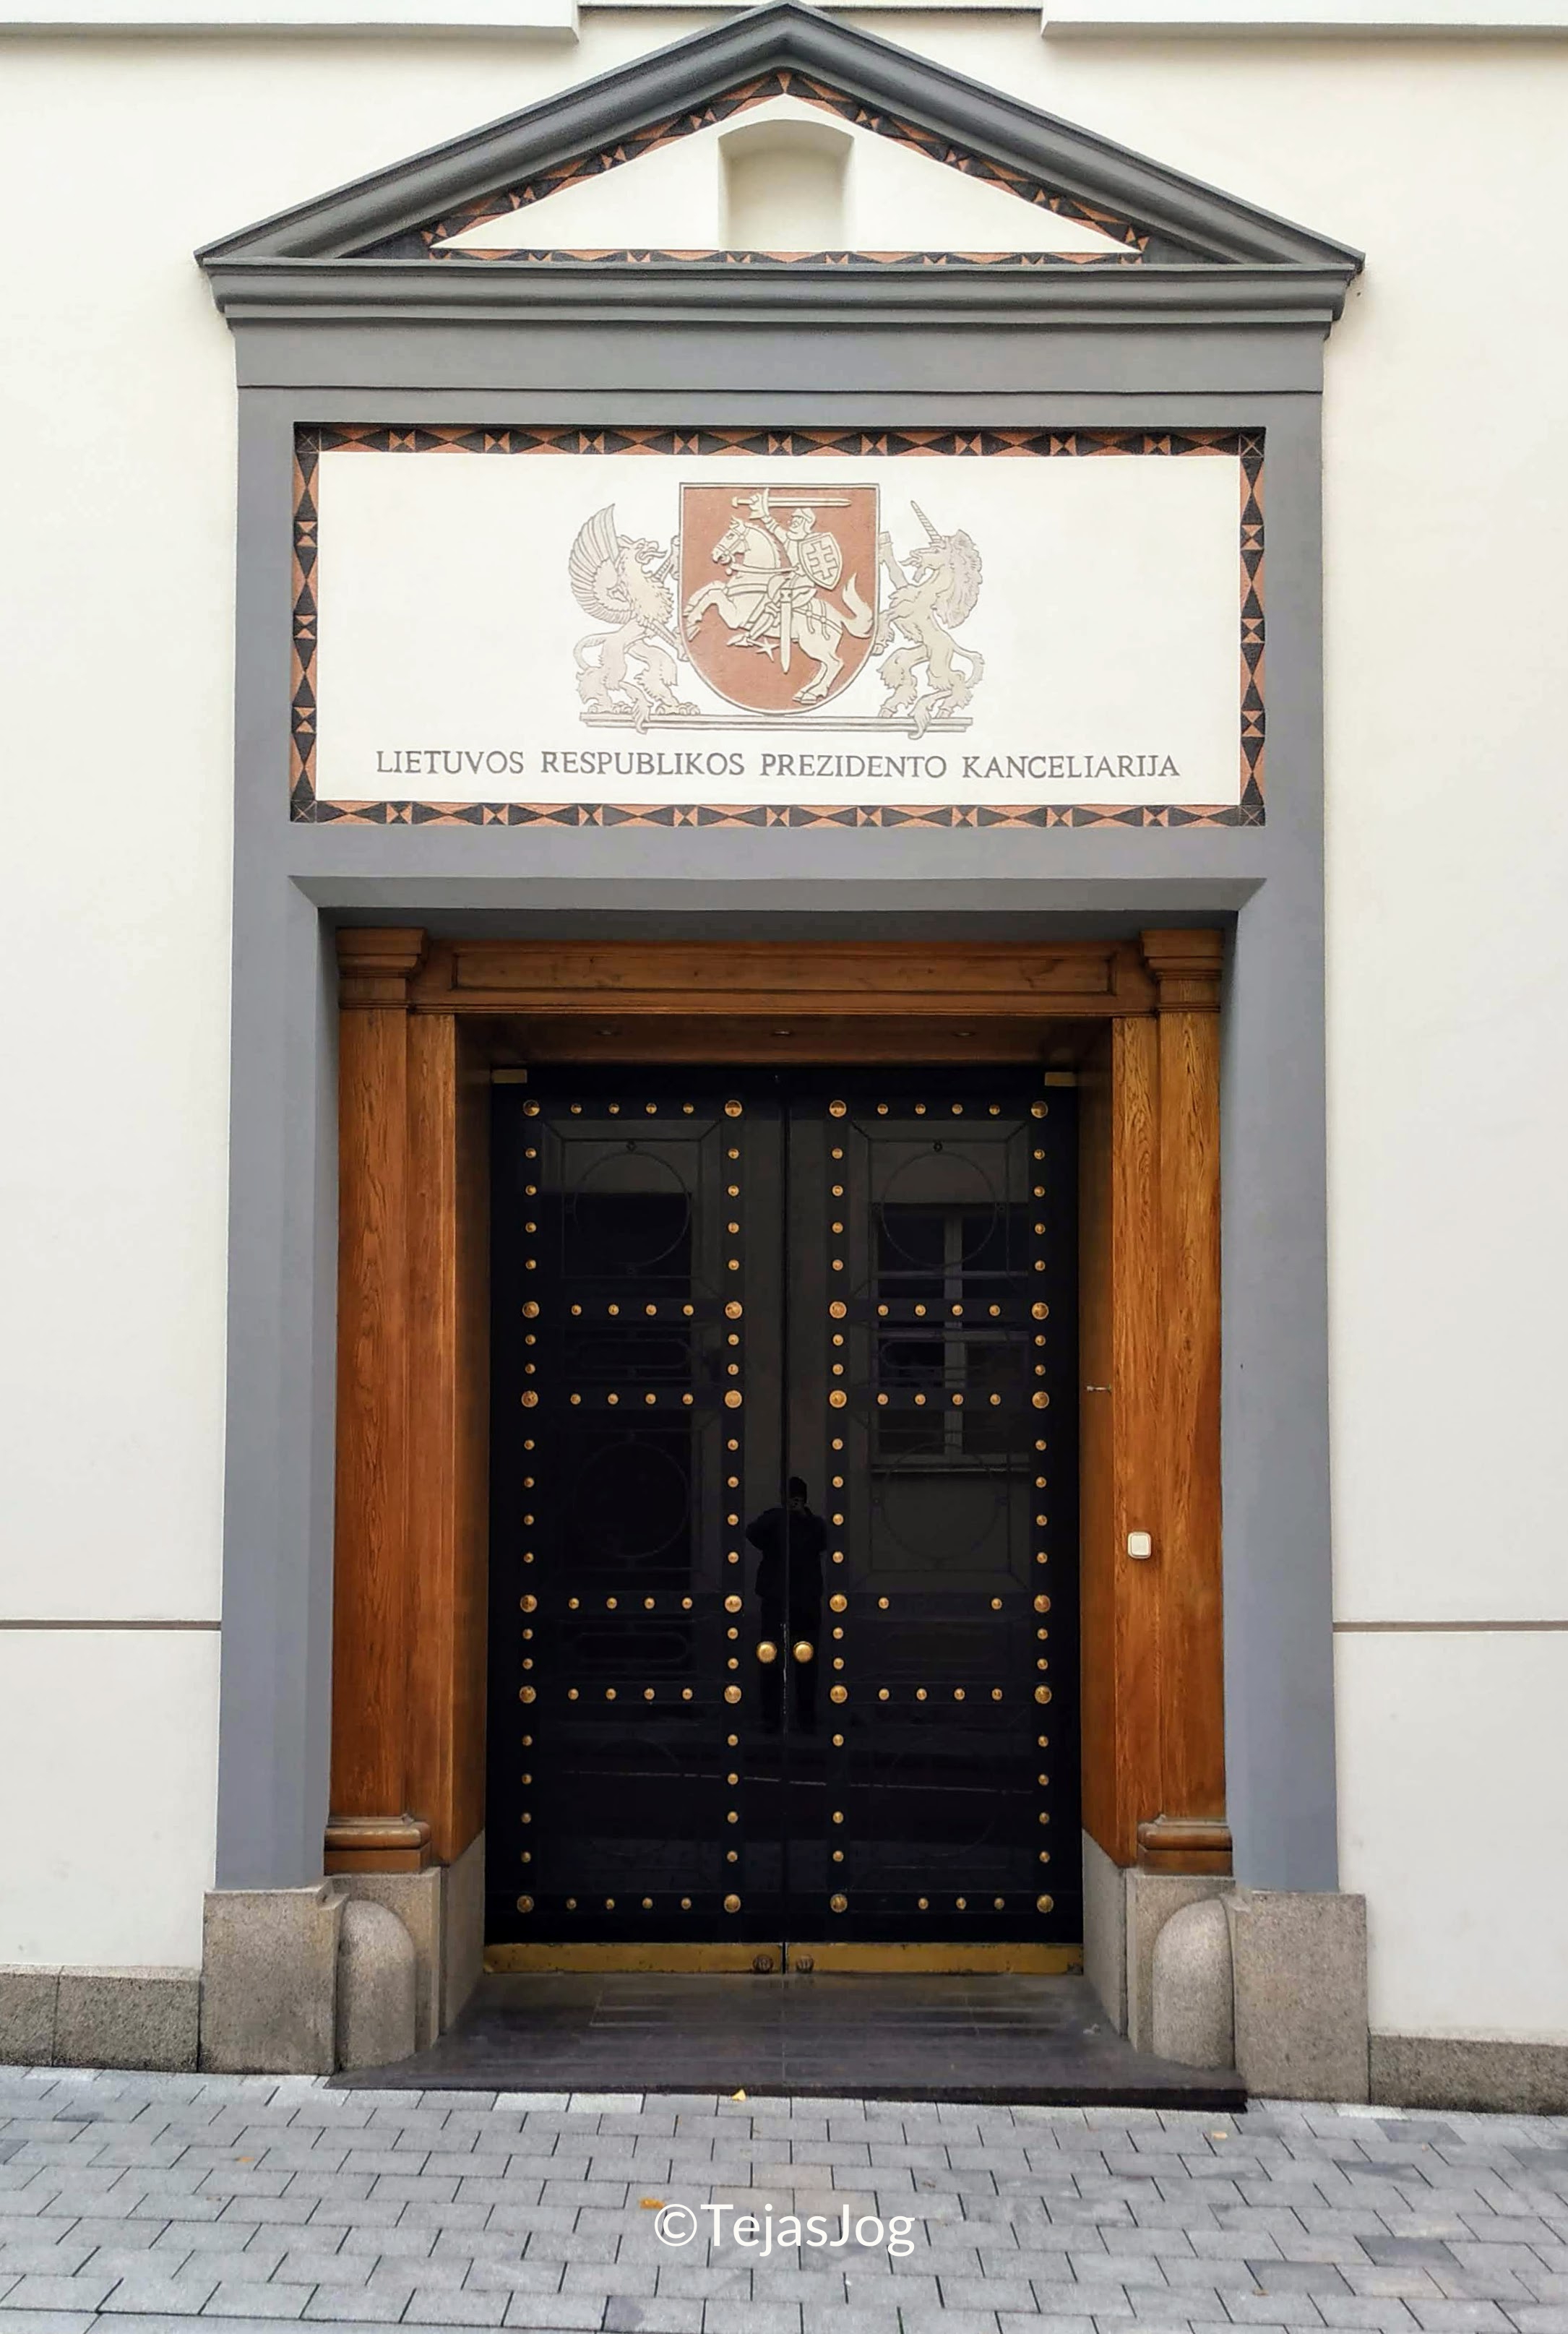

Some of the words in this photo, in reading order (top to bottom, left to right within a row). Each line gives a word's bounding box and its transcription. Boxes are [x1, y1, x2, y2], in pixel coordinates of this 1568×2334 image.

[376, 750, 524, 775] LIETUVOS
[540, 751, 745, 776] RESPUBLIKOS
[759, 753, 947, 778] PREZIDENTO
[962, 754, 1181, 779] KANCELIARIJA
